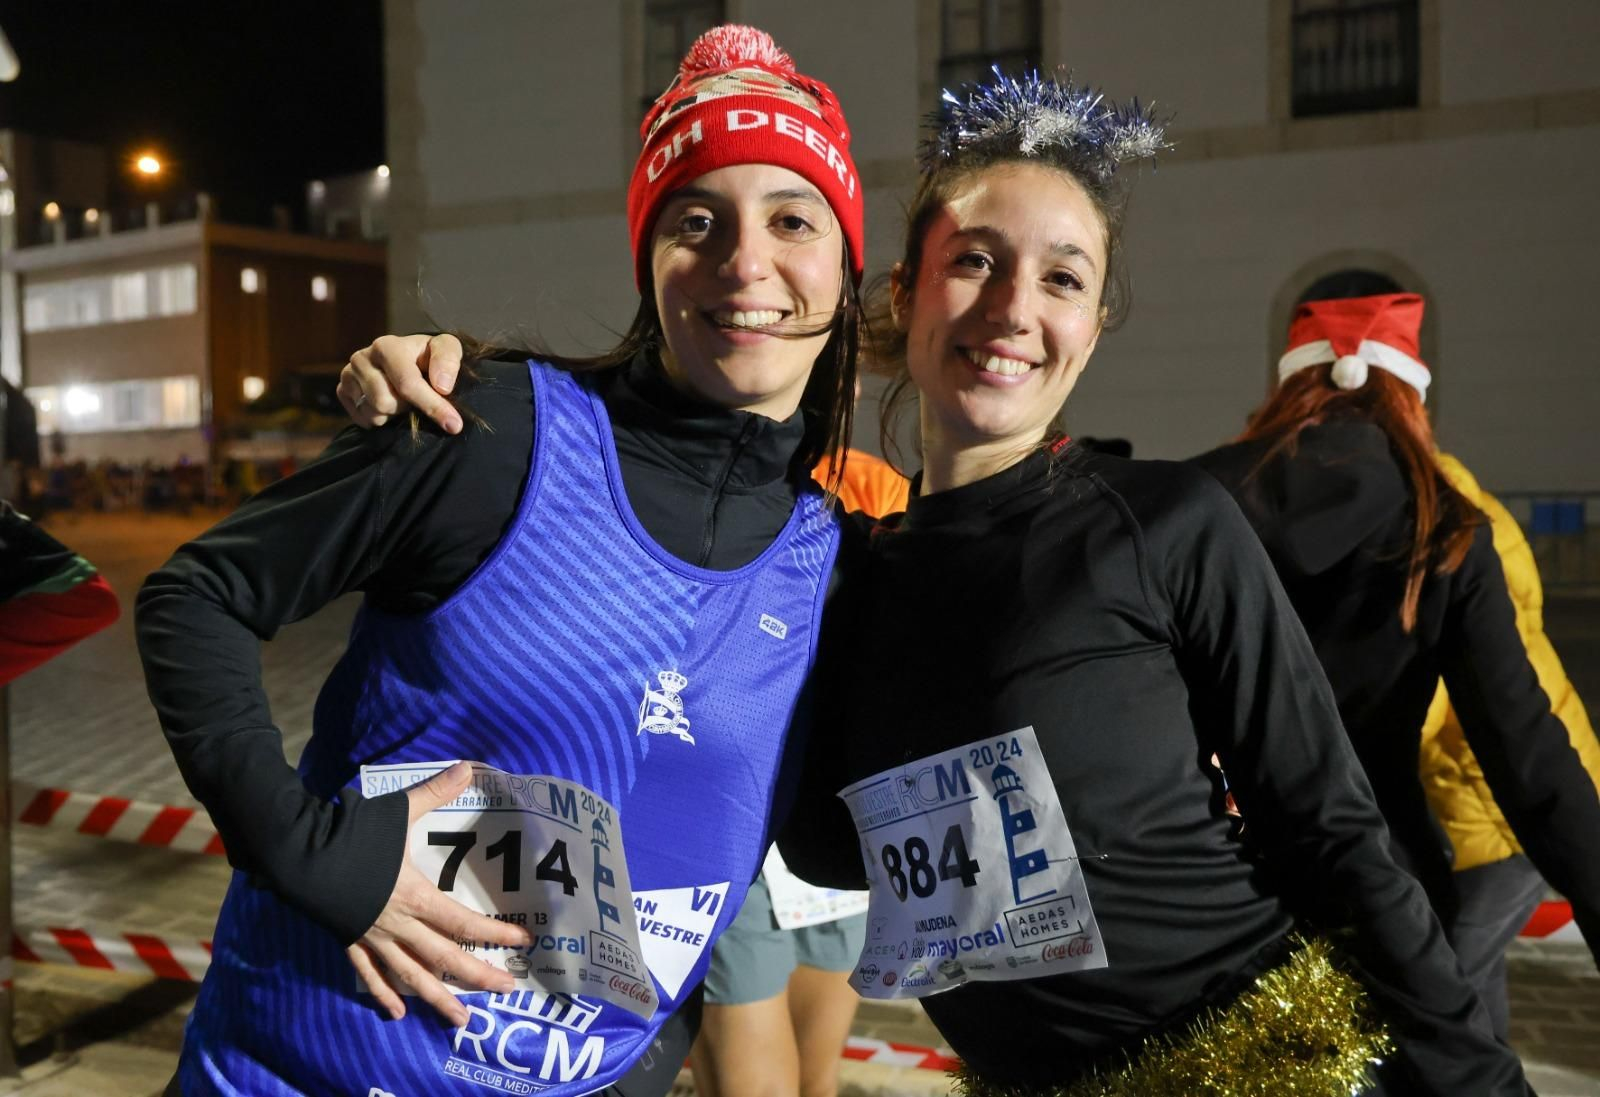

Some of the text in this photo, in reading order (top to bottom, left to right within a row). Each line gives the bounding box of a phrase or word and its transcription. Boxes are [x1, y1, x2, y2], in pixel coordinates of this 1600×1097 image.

[647, 109, 855, 200] OH DEER!
[366, 775, 402, 795] SAN
[504, 774, 579, 824] RCM
[896, 757, 971, 813] RCM
[427, 830, 579, 897] 714
[882, 823, 980, 902] 884
[633, 896, 658, 916] AN
[690, 886, 721, 916] VI
[534, 912, 548, 925] 13
[1018, 906, 1065, 925] AEDAS
[1021, 919, 1069, 938] HOMES
[484, 934, 586, 957] yoral
[640, 917, 704, 946] VESTRE
[927, 922, 1005, 959] mayoral
[600, 941, 634, 963] AEDAS
[600, 952, 637, 973] HOMES
[454, 1004, 605, 1082] RCM
[444, 1059, 472, 1078] REAL
[473, 1069, 502, 1087] CLUB
